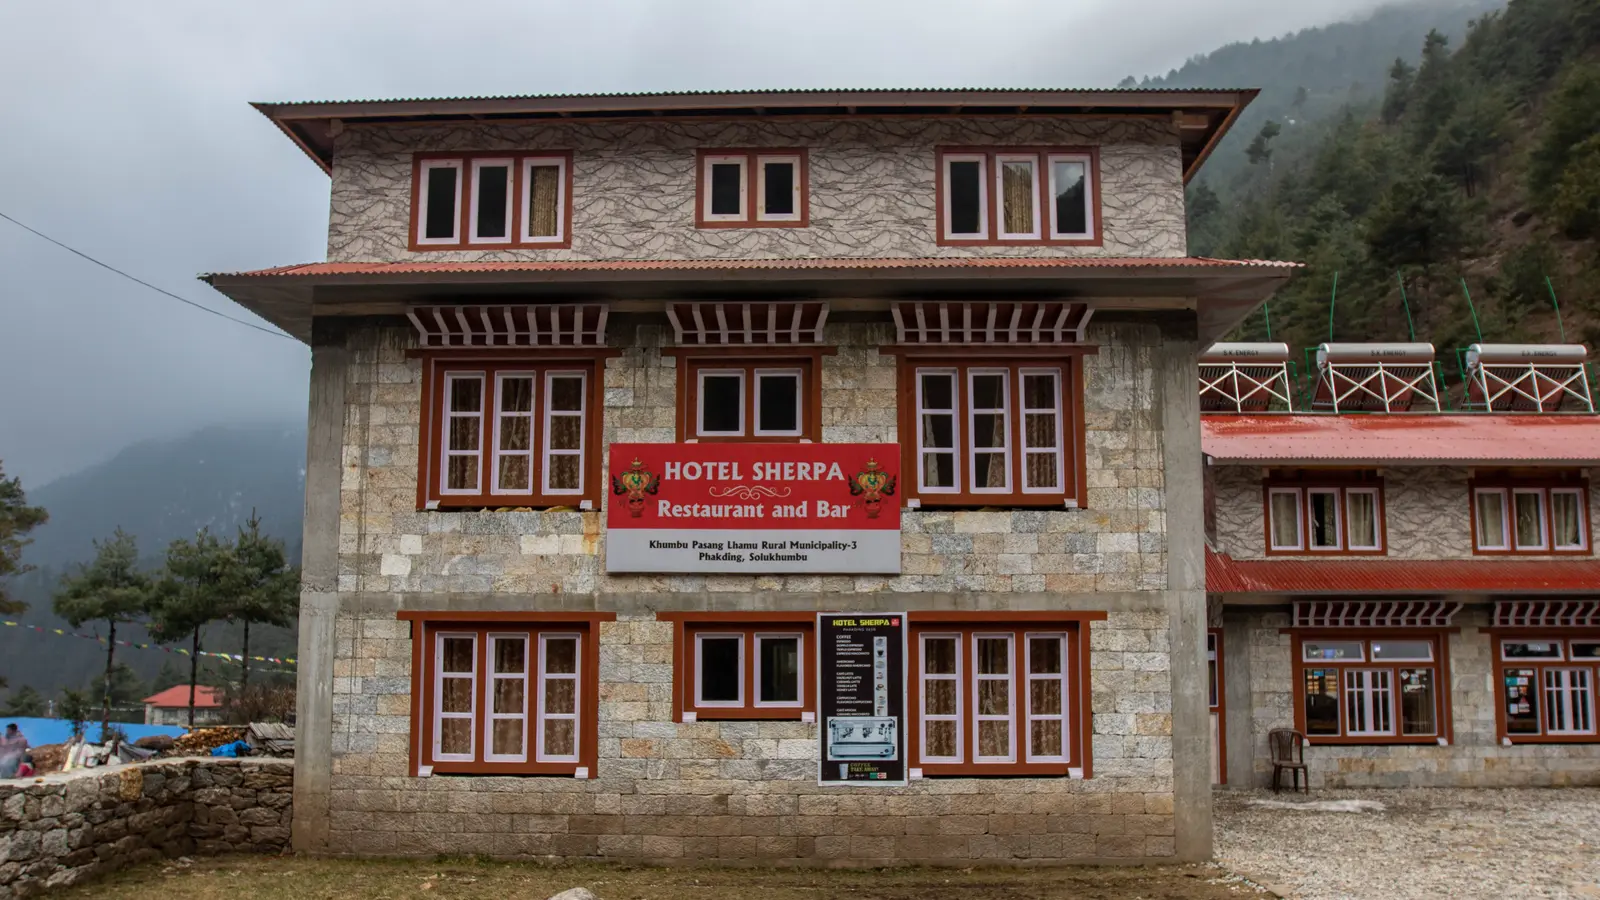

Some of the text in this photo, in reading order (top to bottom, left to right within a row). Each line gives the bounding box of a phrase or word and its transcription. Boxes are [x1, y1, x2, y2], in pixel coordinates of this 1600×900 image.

[664, 461, 845, 481] HOTEL SHERPA
[657, 500, 851, 518] Restaurant and Bar
[649, 540, 857, 551] Khumbu Pasang Lhamu Rural Municipality-3
[699, 552, 808, 563] Phakding, Solukhumbu
